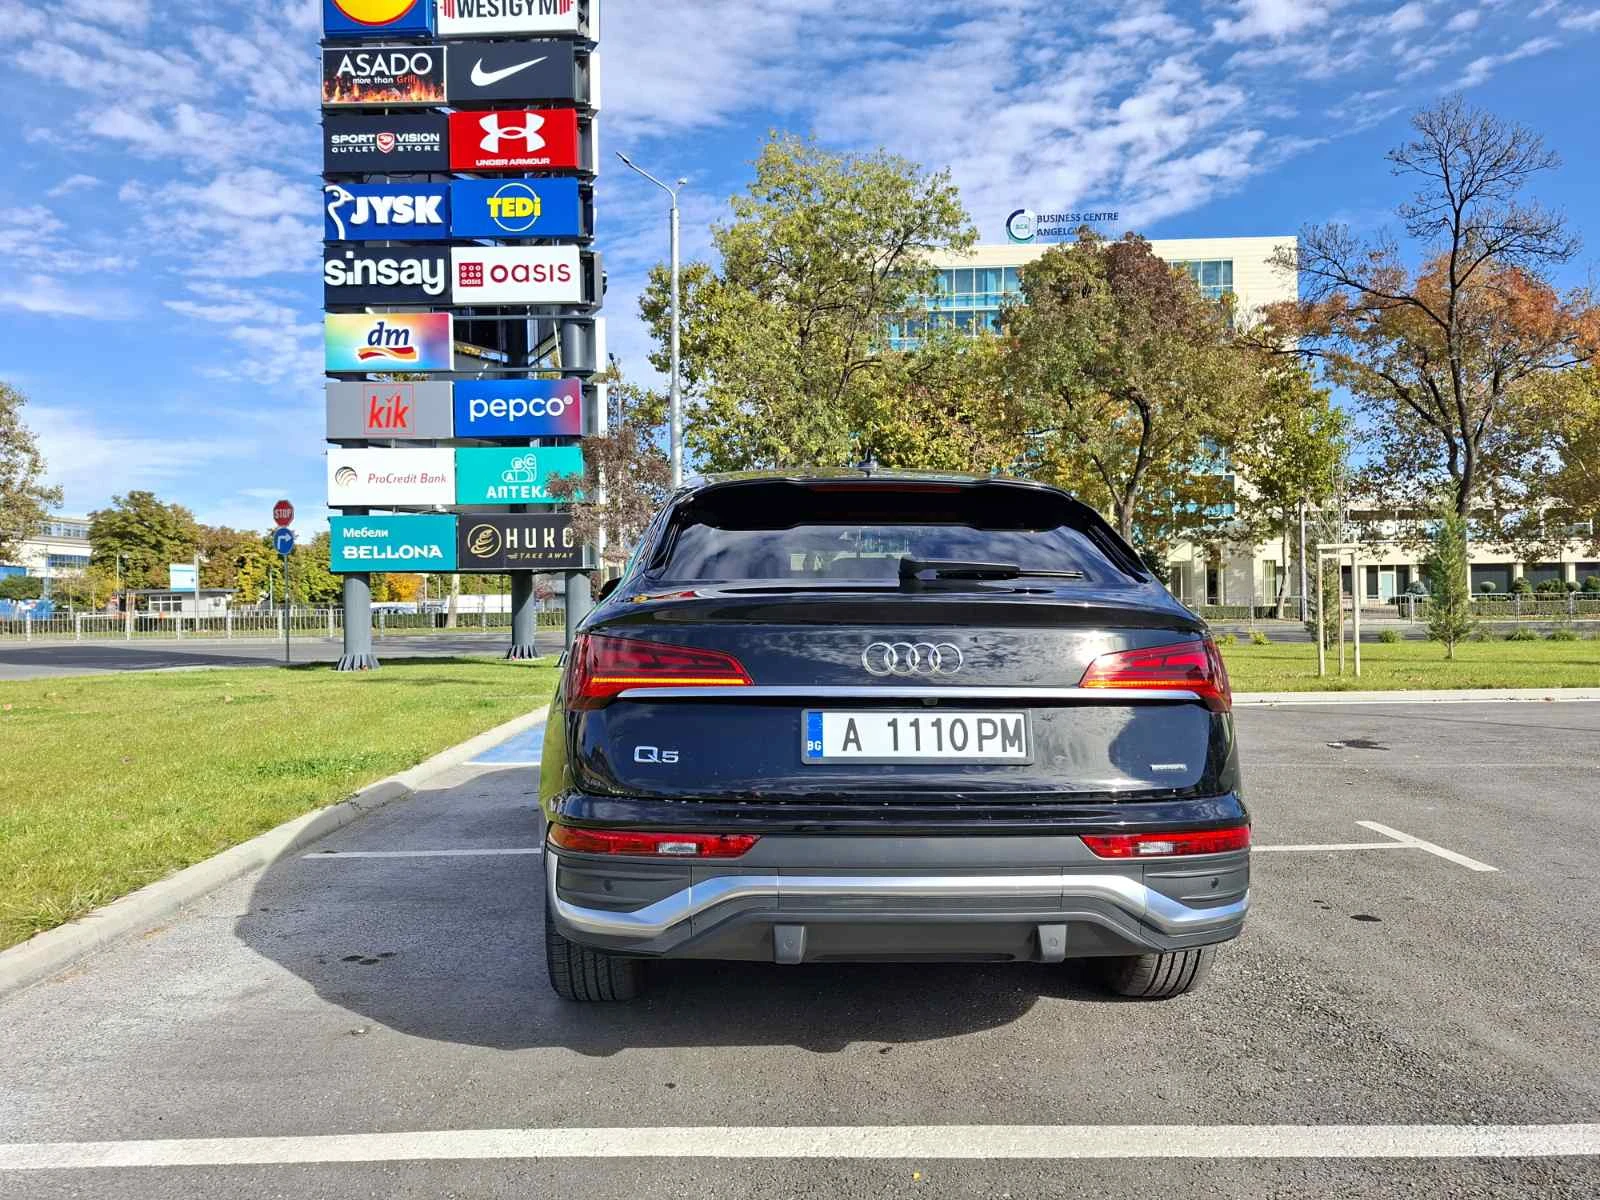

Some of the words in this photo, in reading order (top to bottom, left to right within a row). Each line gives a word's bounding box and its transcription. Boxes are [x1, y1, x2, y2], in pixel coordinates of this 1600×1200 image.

[337, 52, 433, 76] ASADO
[374, 75, 394, 84] than
[331, 134, 376, 144] SPORT
[396, 132, 440, 142] VISION
[475, 158, 508, 167] UNDER
[509, 157, 550, 166] ARMOUR
[350, 195, 443, 225] JYSK
[487, 196, 542, 218] TEDi
[1036, 213, 1081, 223] BUSINESS
[1083, 211, 1119, 221] CENTRE
[324, 250, 445, 295] sinsay
[490, 263, 571, 283] oasis
[367, 321, 410, 346] dm
[368, 394, 409, 428] kik
[469, 398, 565, 422] pepco
[368, 472, 418, 484] ProCredit
[420, 472, 447, 484] Bank
[274, 508, 292, 519] STOP
[343, 527, 389, 538] Мебели
[342, 544, 444, 559] BELLONA
[520, 552, 543, 560] TAKE
[547, 551, 574, 559] AWAY
[842, 717, 863, 752] A
[807, 740, 822, 751] BG
[633, 745, 679, 763] Q5
